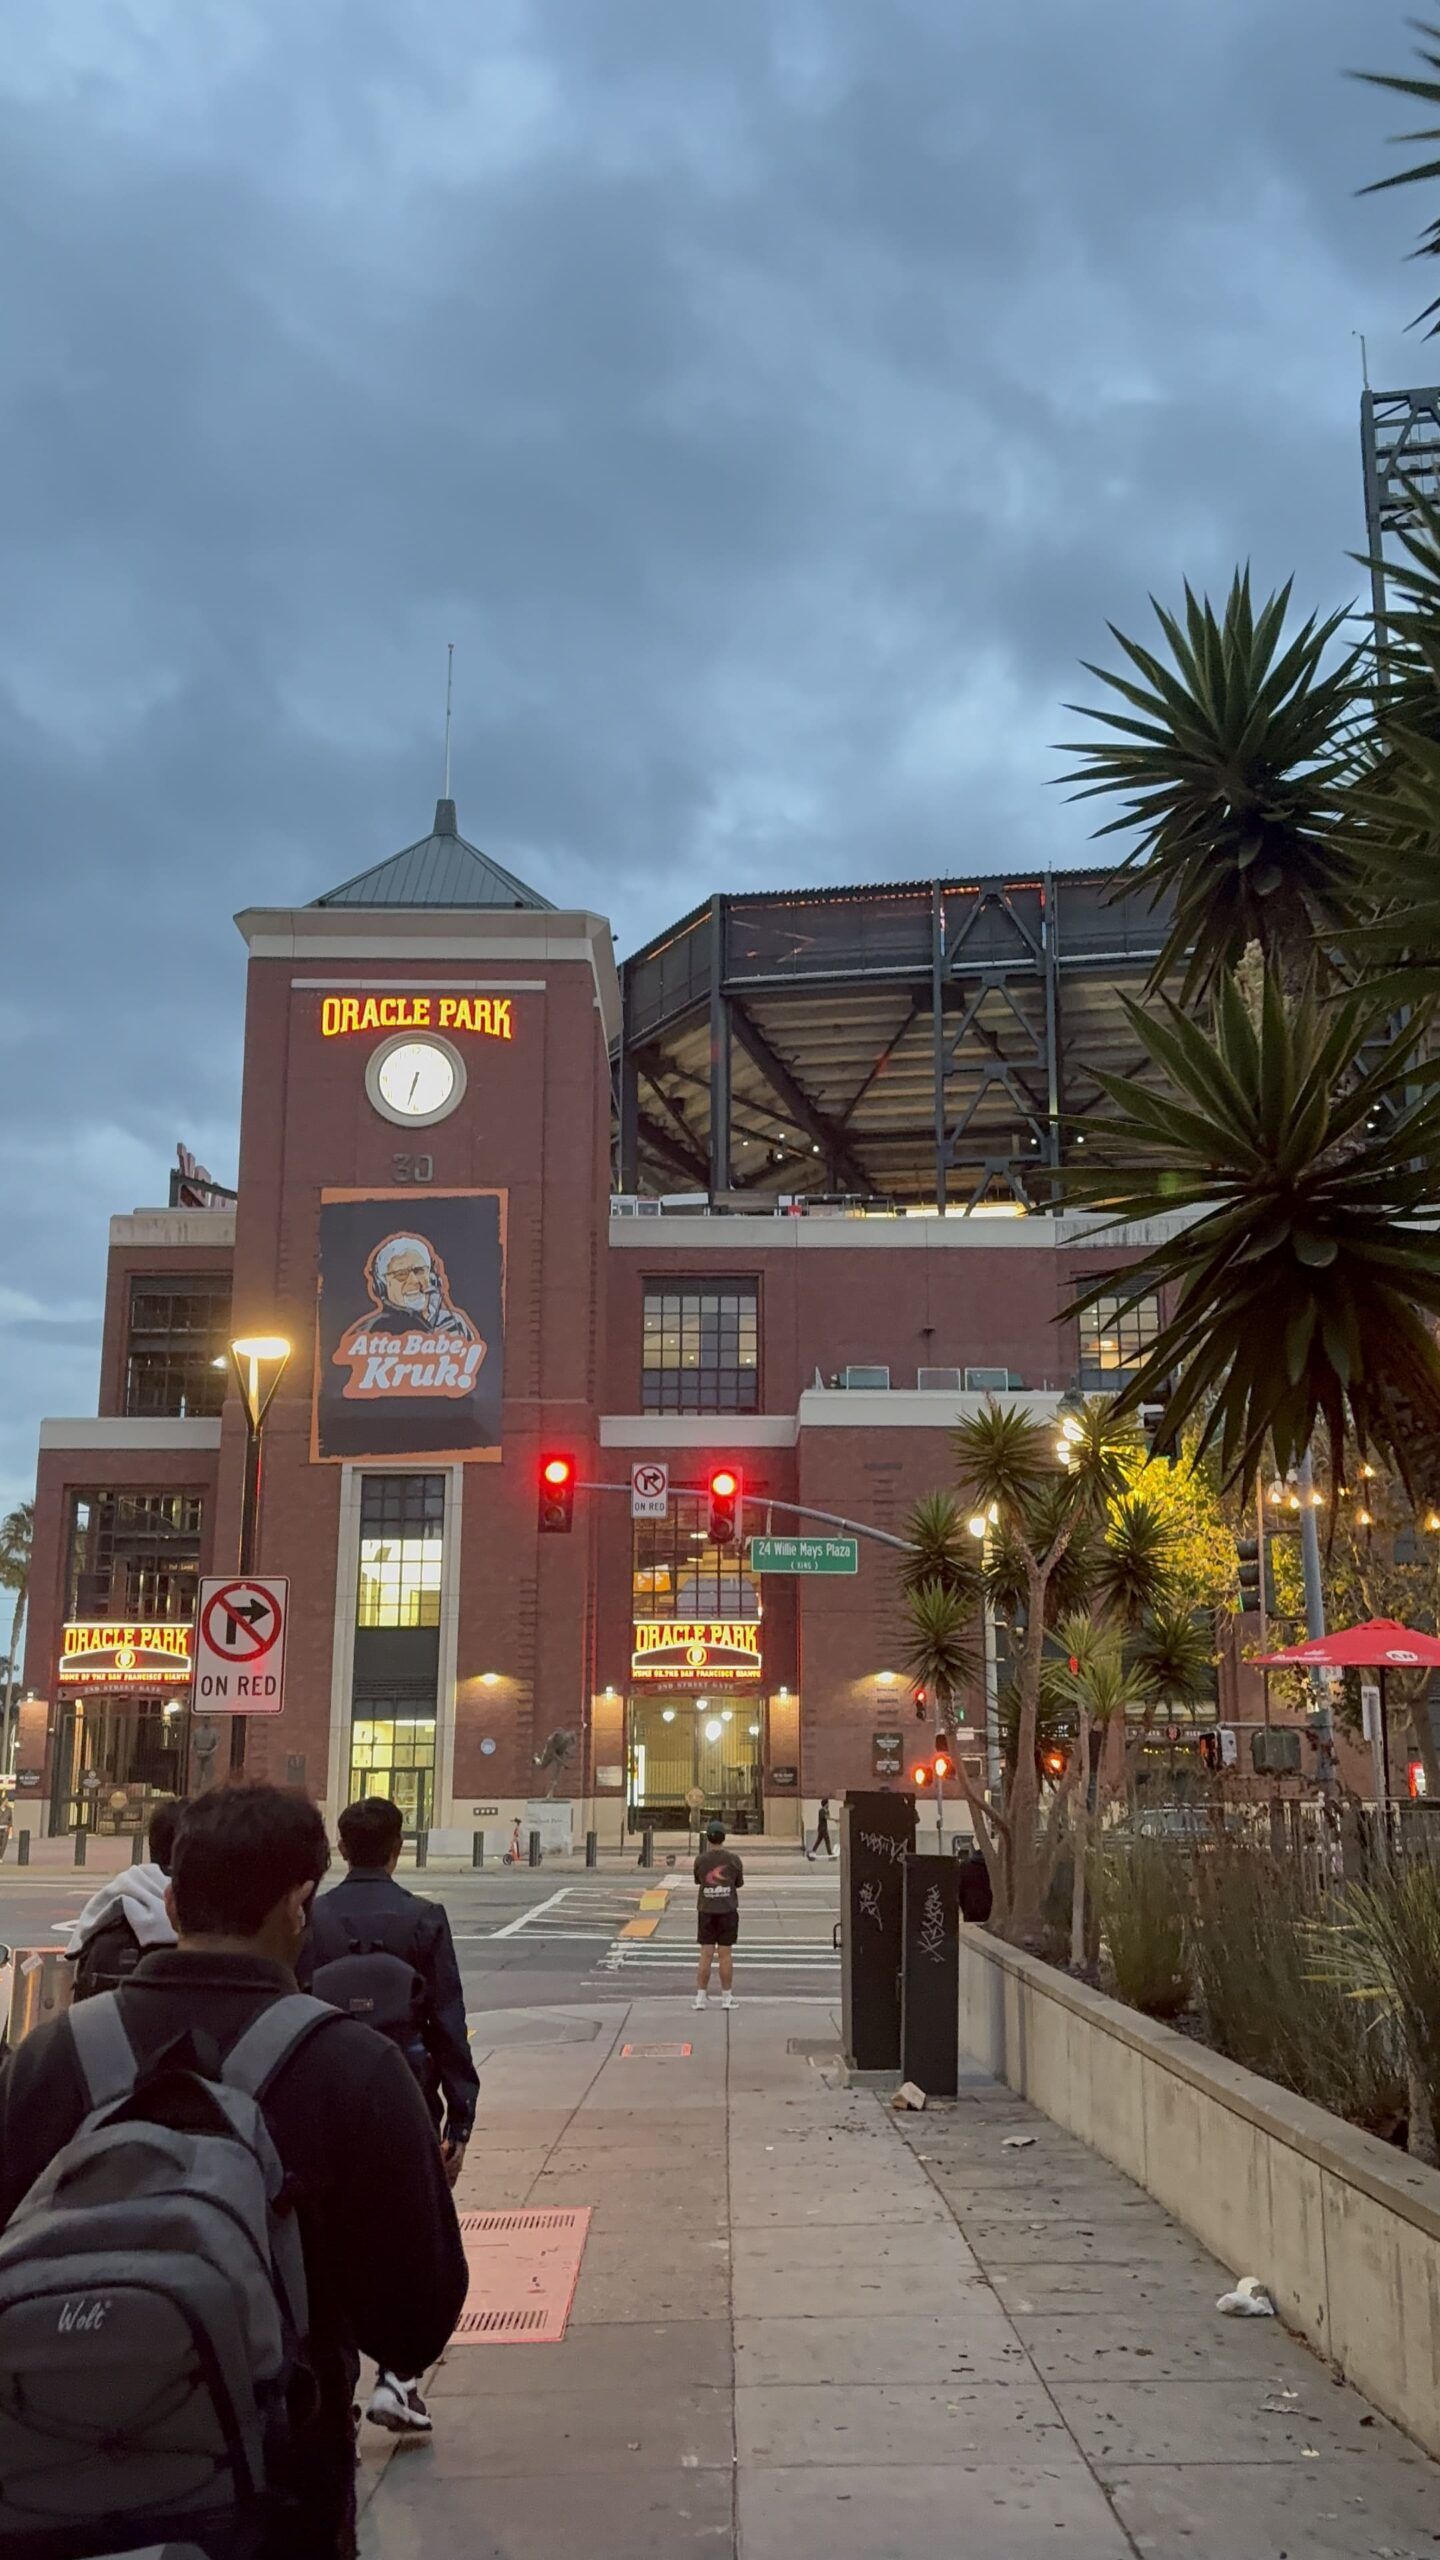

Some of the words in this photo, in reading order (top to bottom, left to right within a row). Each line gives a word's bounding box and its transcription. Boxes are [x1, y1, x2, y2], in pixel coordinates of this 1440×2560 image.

[321, 997, 431, 1037] ORACLE
[438, 997, 512, 1040] PARK
[393, 1153, 434, 1182] 30
[348, 1335, 401, 1355] Atta
[402, 1334, 466, 1357] Babe,
[358, 1344, 482, 1389] Kruk!
[634, 1502, 646, 1511] ON
[648, 1502, 665, 1511] RED
[758, 1541, 771, 1556] 24
[773, 1542, 797, 1557] Willie
[800, 1542, 823, 1559] Mays
[826, 1542, 851, 1558] Plaza
[64, 1628, 135, 1655] ORACLE
[140, 1628, 188, 1656] PARK
[636, 1625, 706, 1652] ORACLE
[710, 1625, 758, 1653] PARK
[59, 1672, 80, 1681] HOME
[92, 1672, 106, 1681] THE
[108, 1672, 121, 1681] SAN
[124, 1672, 162, 1681] FRANCISCO
[164, 1672, 190, 1681] GIANTS
[632, 1669, 652, 1678] HOME
[680, 1669, 695, 1678] SAN
[696, 1669, 734, 1678] FRANCISCO
[201, 1675, 228, 1697] ON
[237, 1675, 277, 1697] RED
